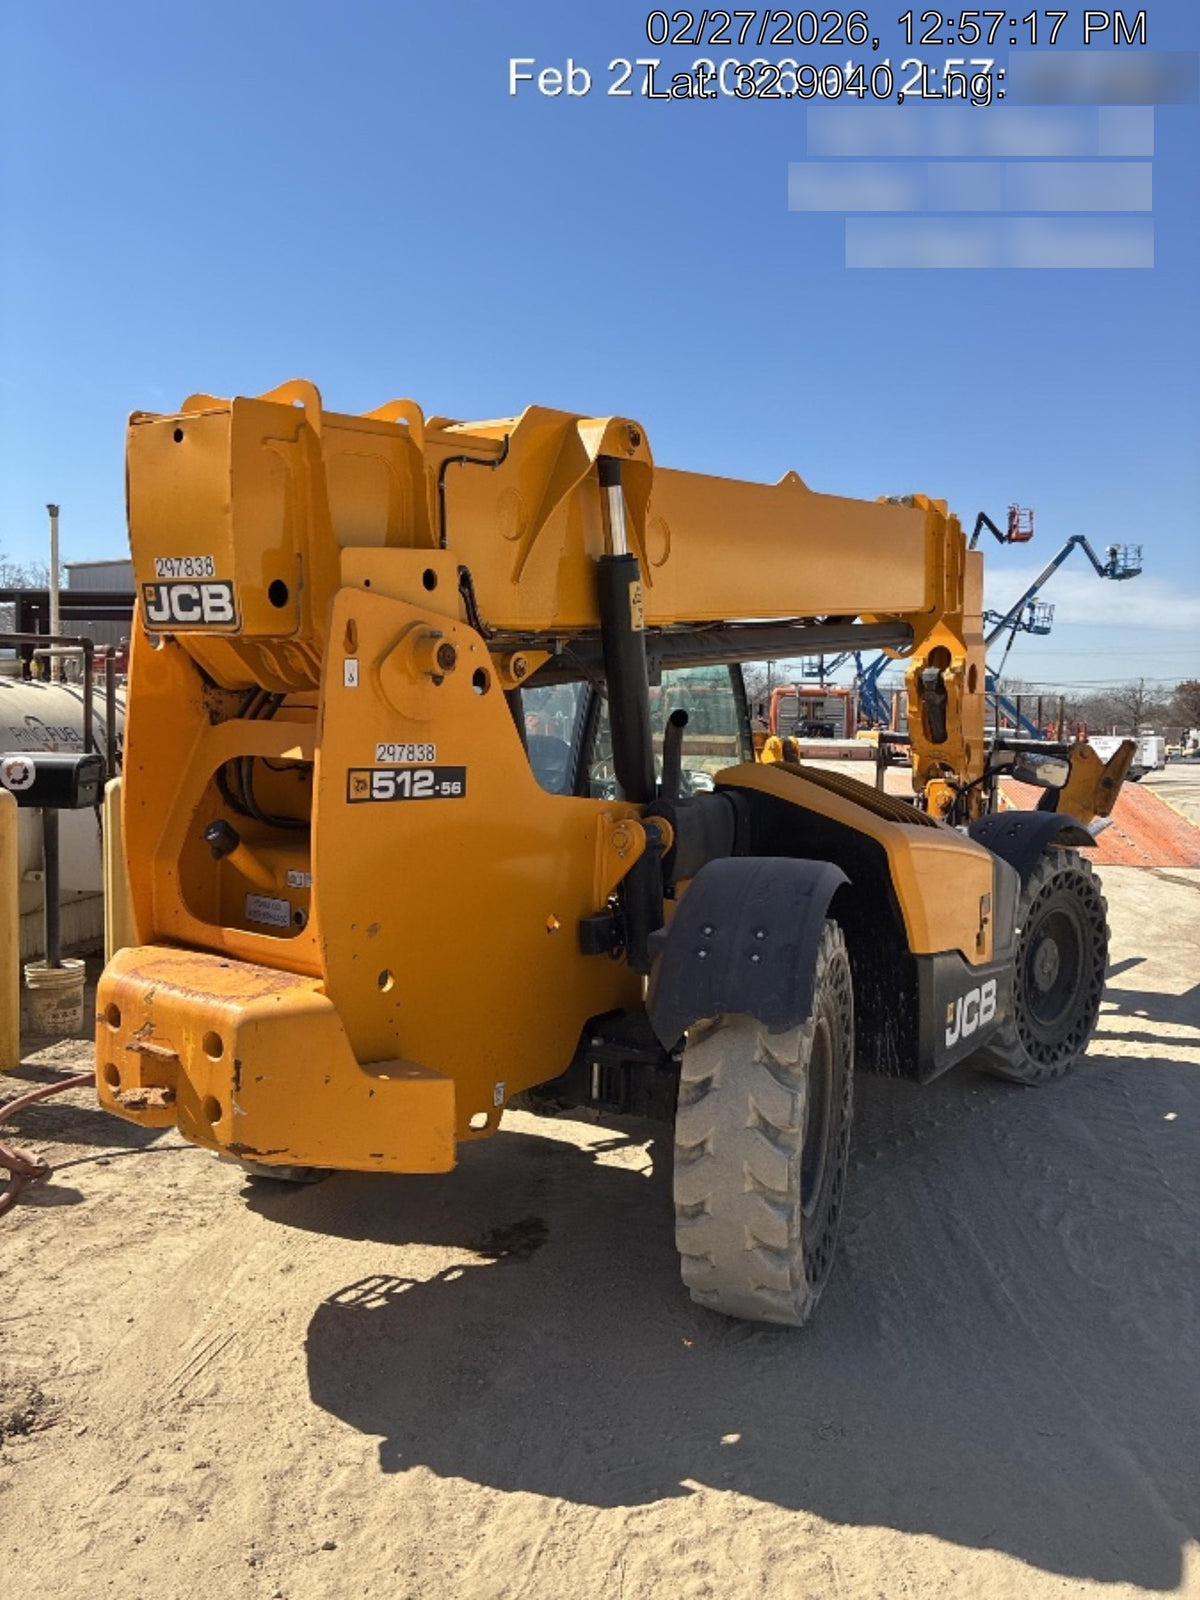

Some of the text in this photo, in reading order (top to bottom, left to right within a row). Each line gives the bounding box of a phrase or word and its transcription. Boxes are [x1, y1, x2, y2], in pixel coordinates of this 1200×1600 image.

[155, 556, 214, 577] 297838
[147, 584, 234, 622] JCB
[376, 744, 435, 761] 297838
[945, 978, 997, 1048] JCB
